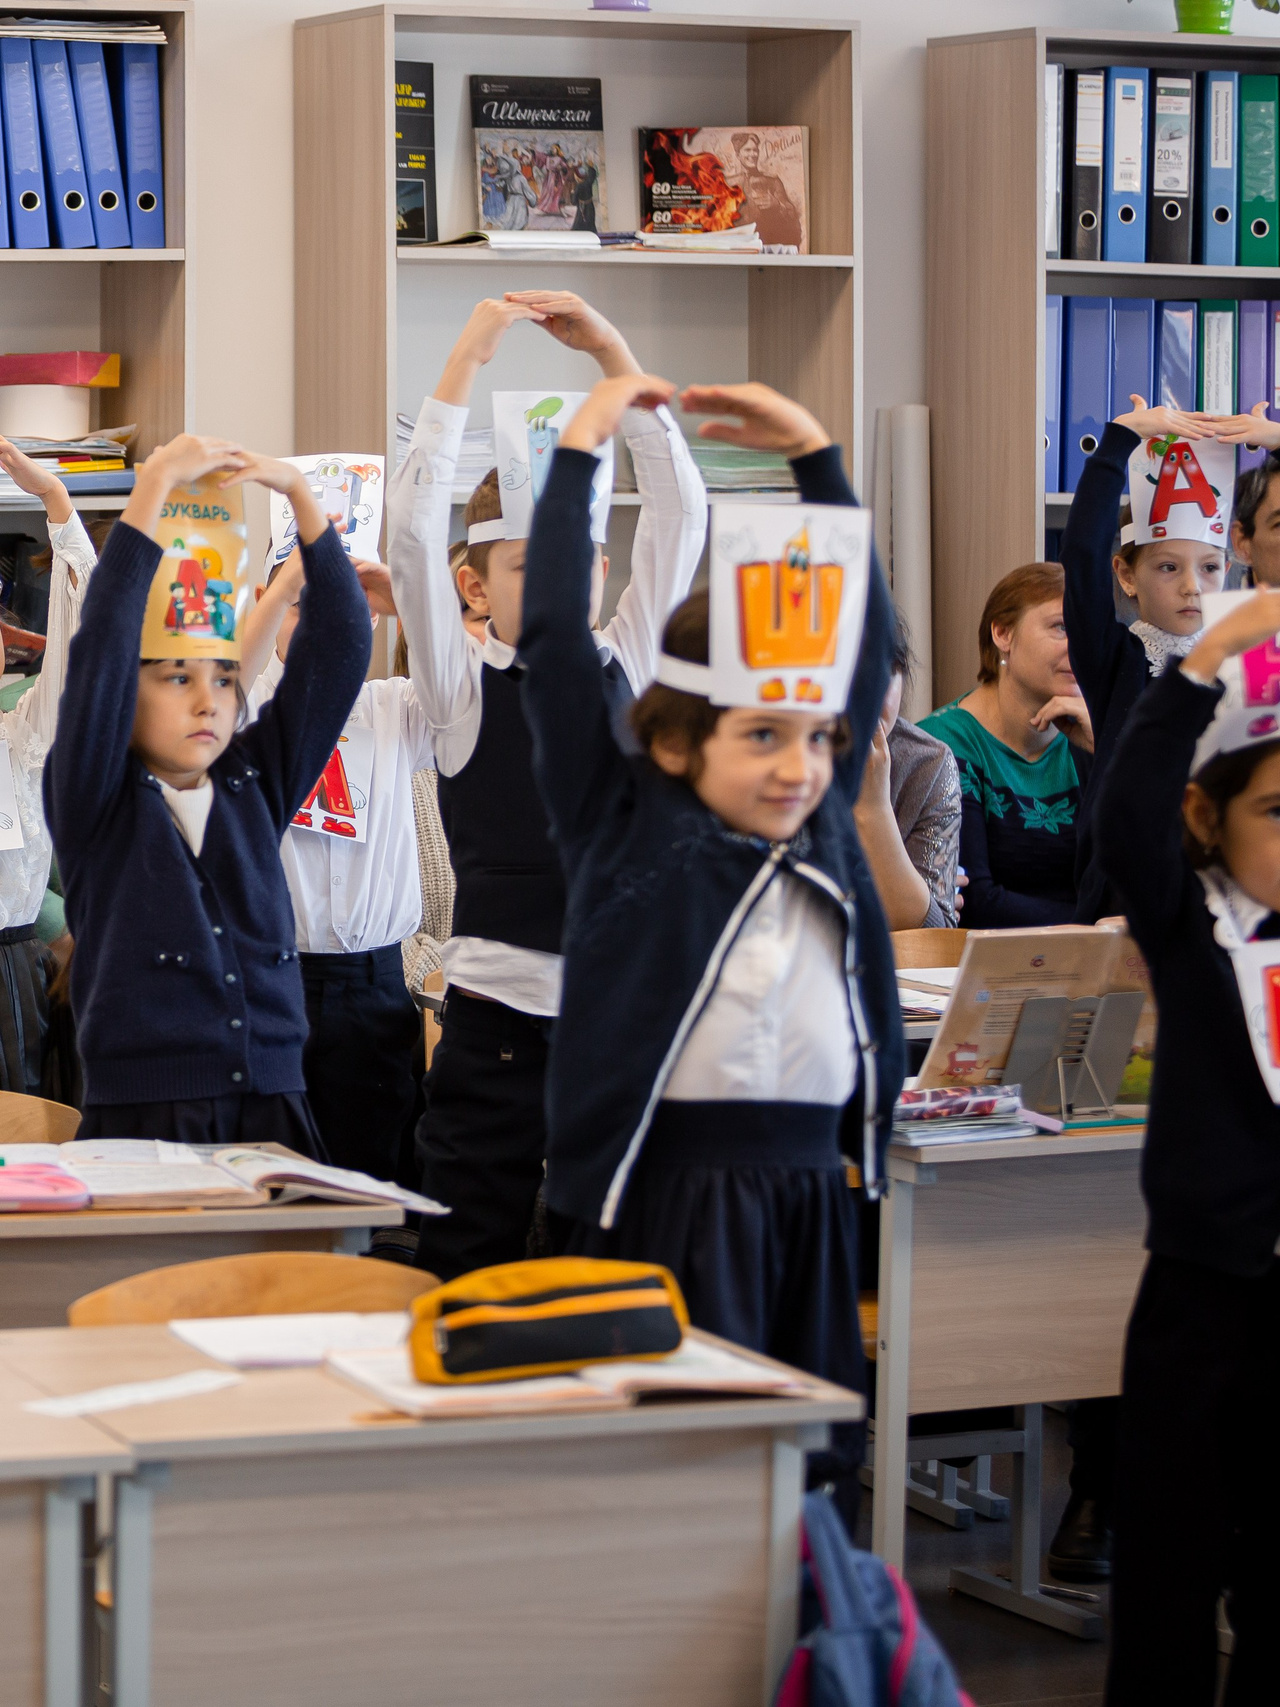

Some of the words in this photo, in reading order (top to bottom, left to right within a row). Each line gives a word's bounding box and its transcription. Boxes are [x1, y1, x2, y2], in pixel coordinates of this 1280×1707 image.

[561, 108, 591, 122] хан
[1157, 148, 1170, 160] 20
[651, 182, 671, 195] 60
[652, 211, 672, 223] 60
[1148, 441, 1220, 526] А
[736, 556, 844, 669] Ш
